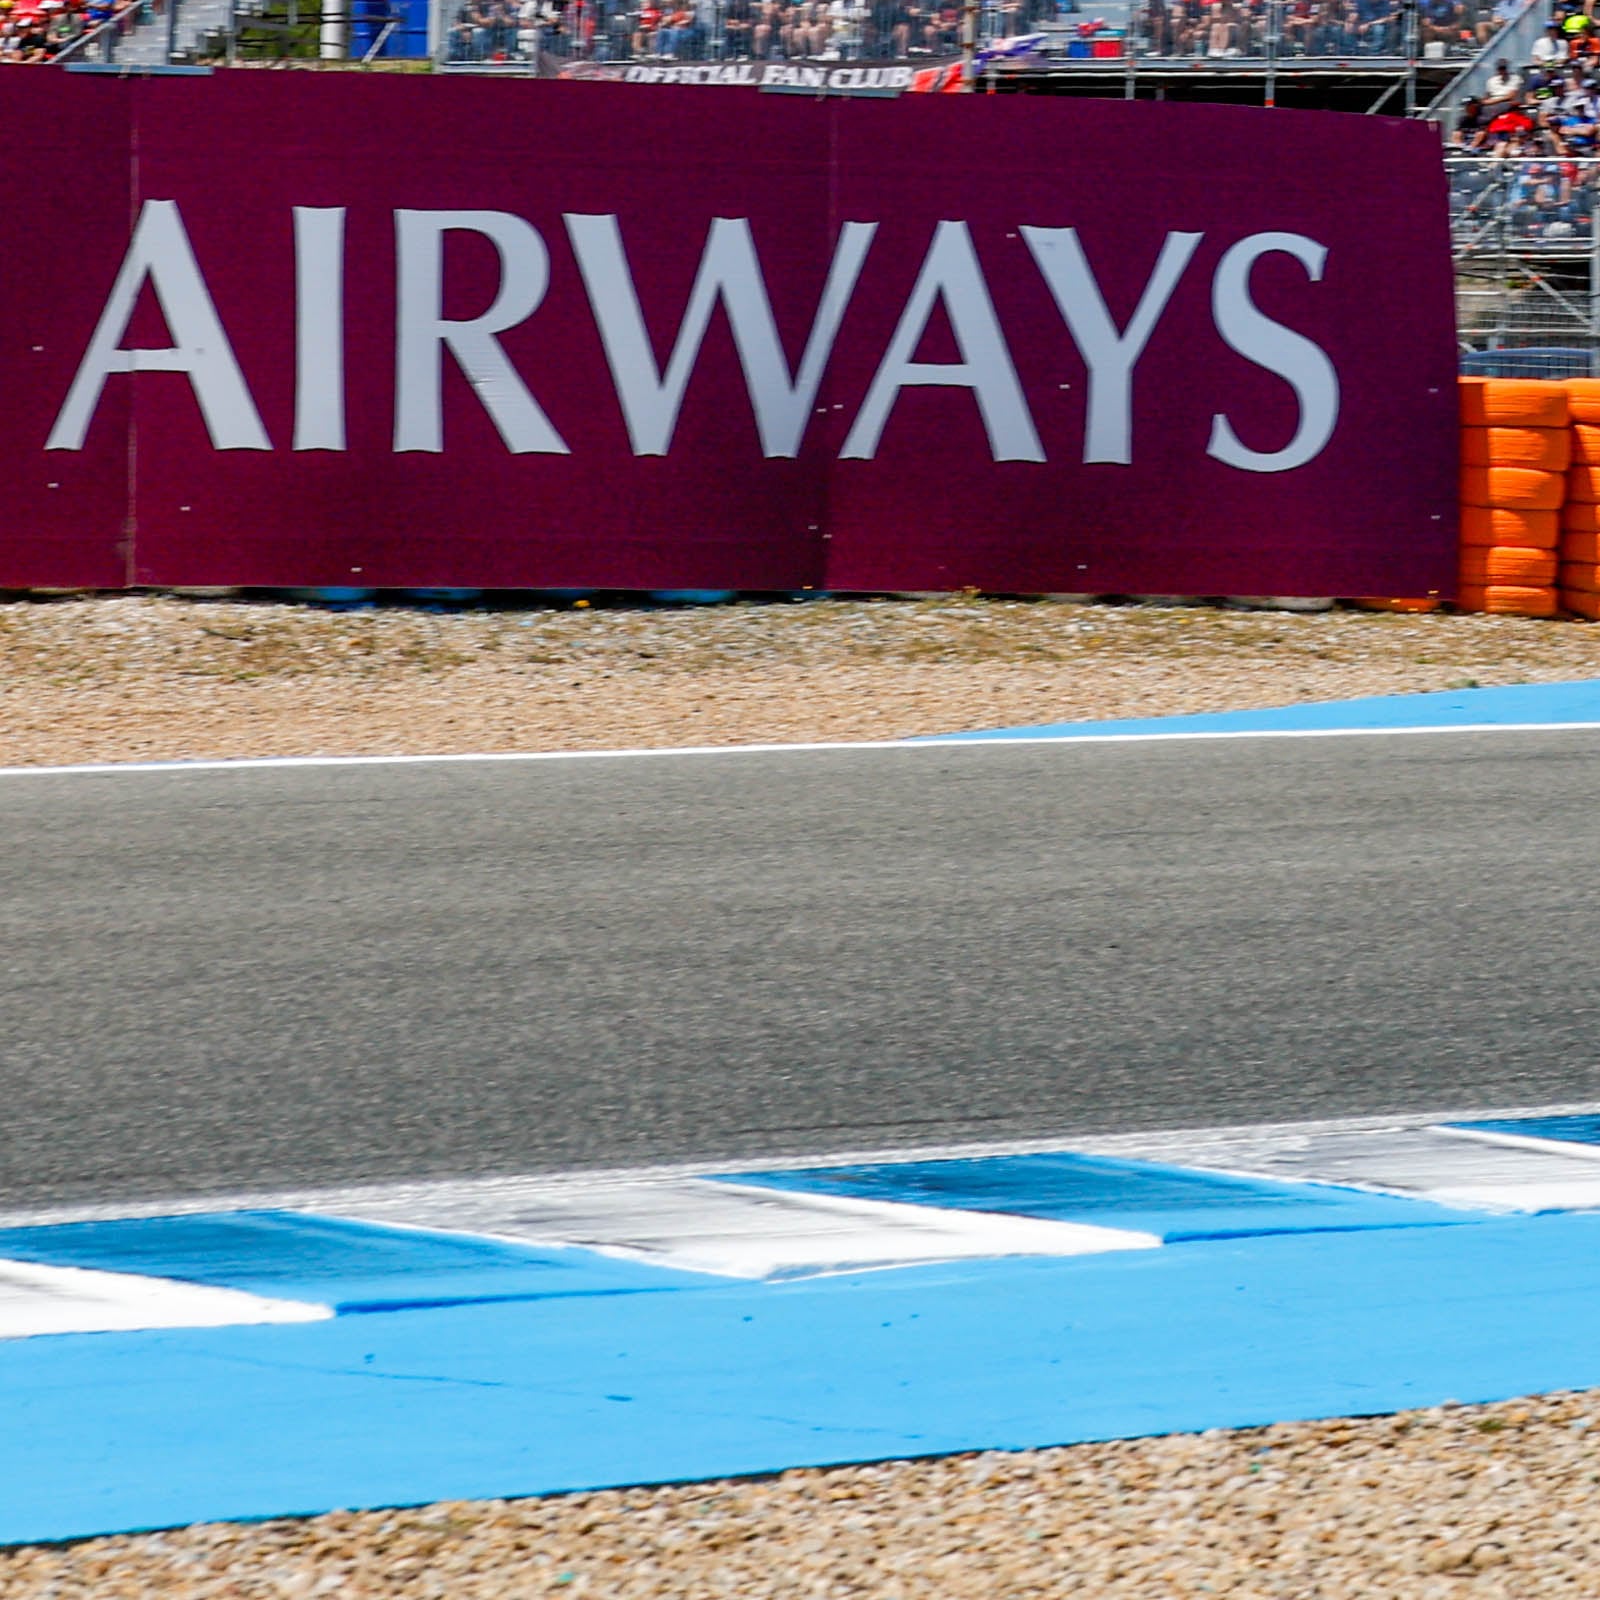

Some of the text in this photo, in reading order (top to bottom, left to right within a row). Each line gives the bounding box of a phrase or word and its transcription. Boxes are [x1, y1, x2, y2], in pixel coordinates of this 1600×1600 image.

[624, 64, 757, 85] OFFICIAL
[760, 64, 824, 87] FAN
[828, 66, 913, 90] CLUB
[45, 199, 1339, 472] AIRWAYS
